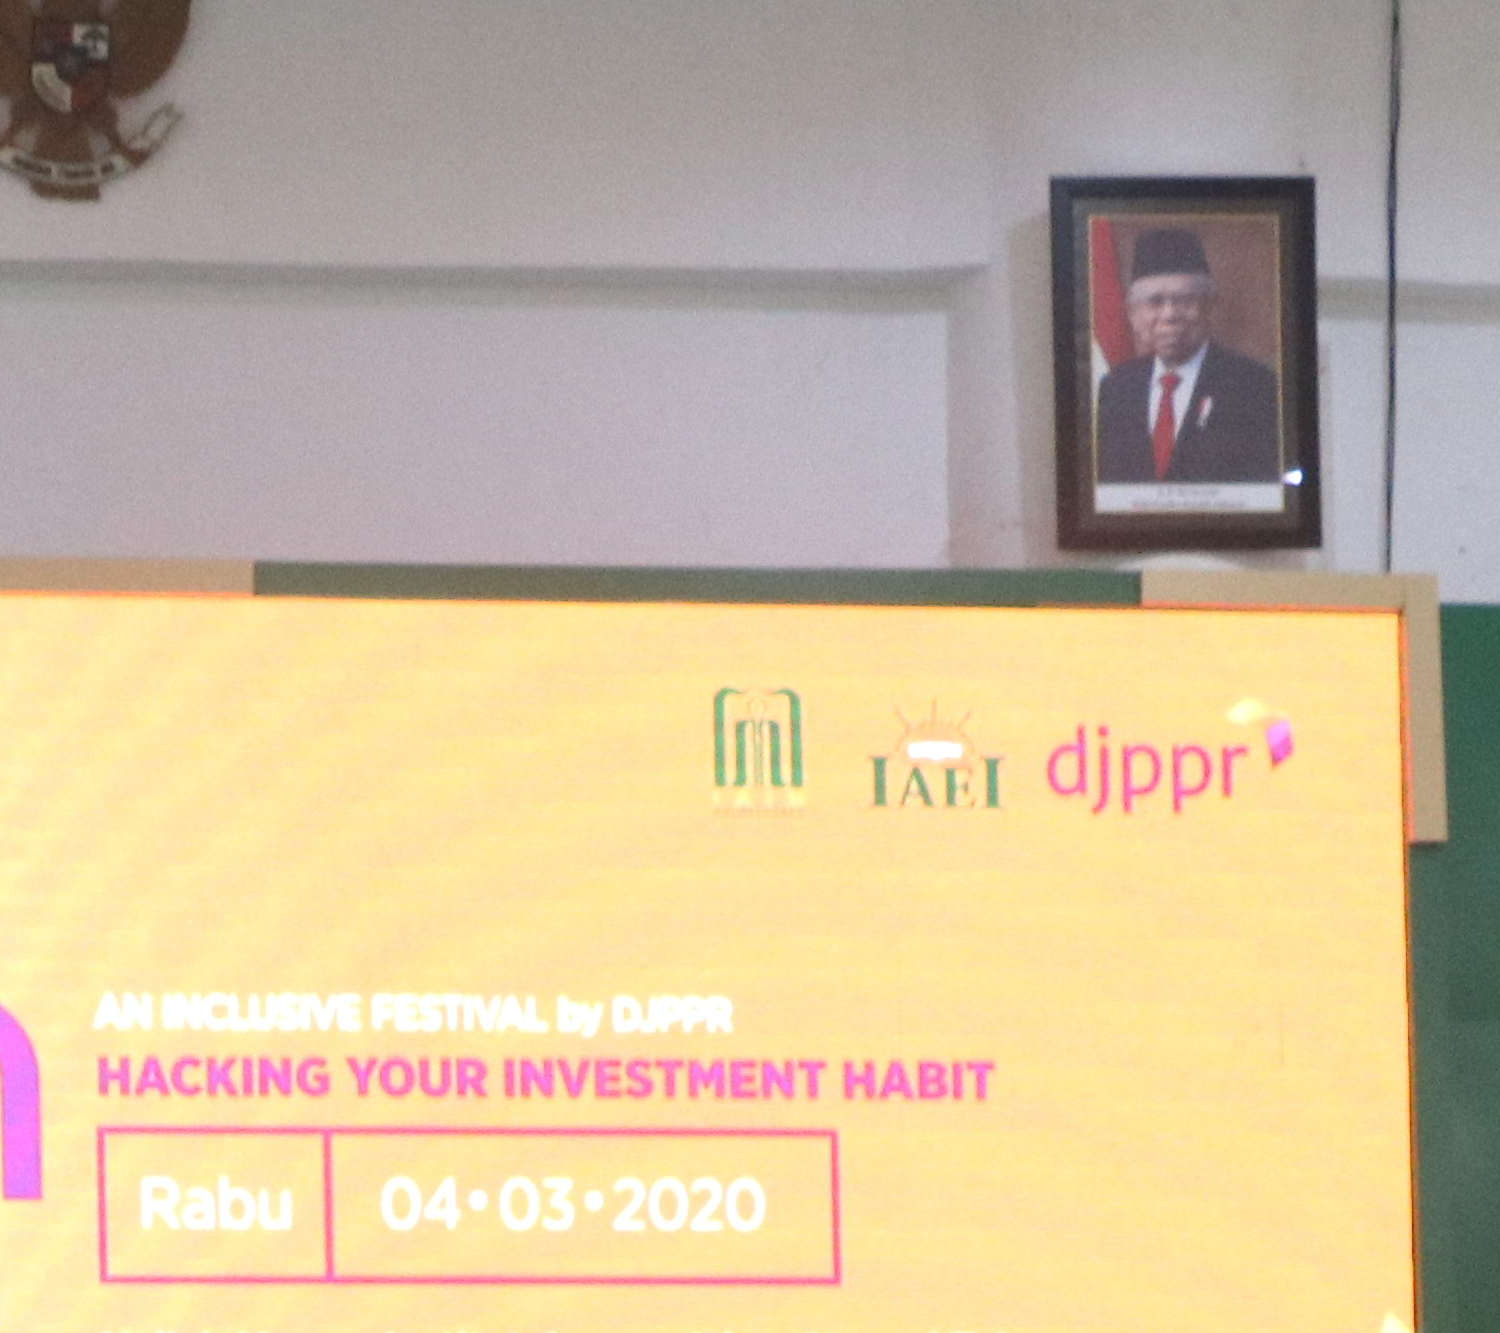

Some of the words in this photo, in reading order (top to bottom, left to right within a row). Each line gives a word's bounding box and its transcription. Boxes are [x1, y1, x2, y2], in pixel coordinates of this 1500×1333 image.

[868, 755, 1003, 809] IAEI
[1046, 725, 1248, 814] djppr
[93, 992, 153, 1030] AN
[161, 992, 361, 1032] INCLUSIVE
[371, 993, 548, 1033] FESTIVAL
[557, 996, 603, 1038] by
[98, 1056, 330, 1097] HACKING
[347, 1056, 487, 1097] YOUR
[504, 1059, 826, 1099] INVESTMENT
[843, 1061, 995, 1100] HABIT
[140, 1175, 292, 1231] Rabu
